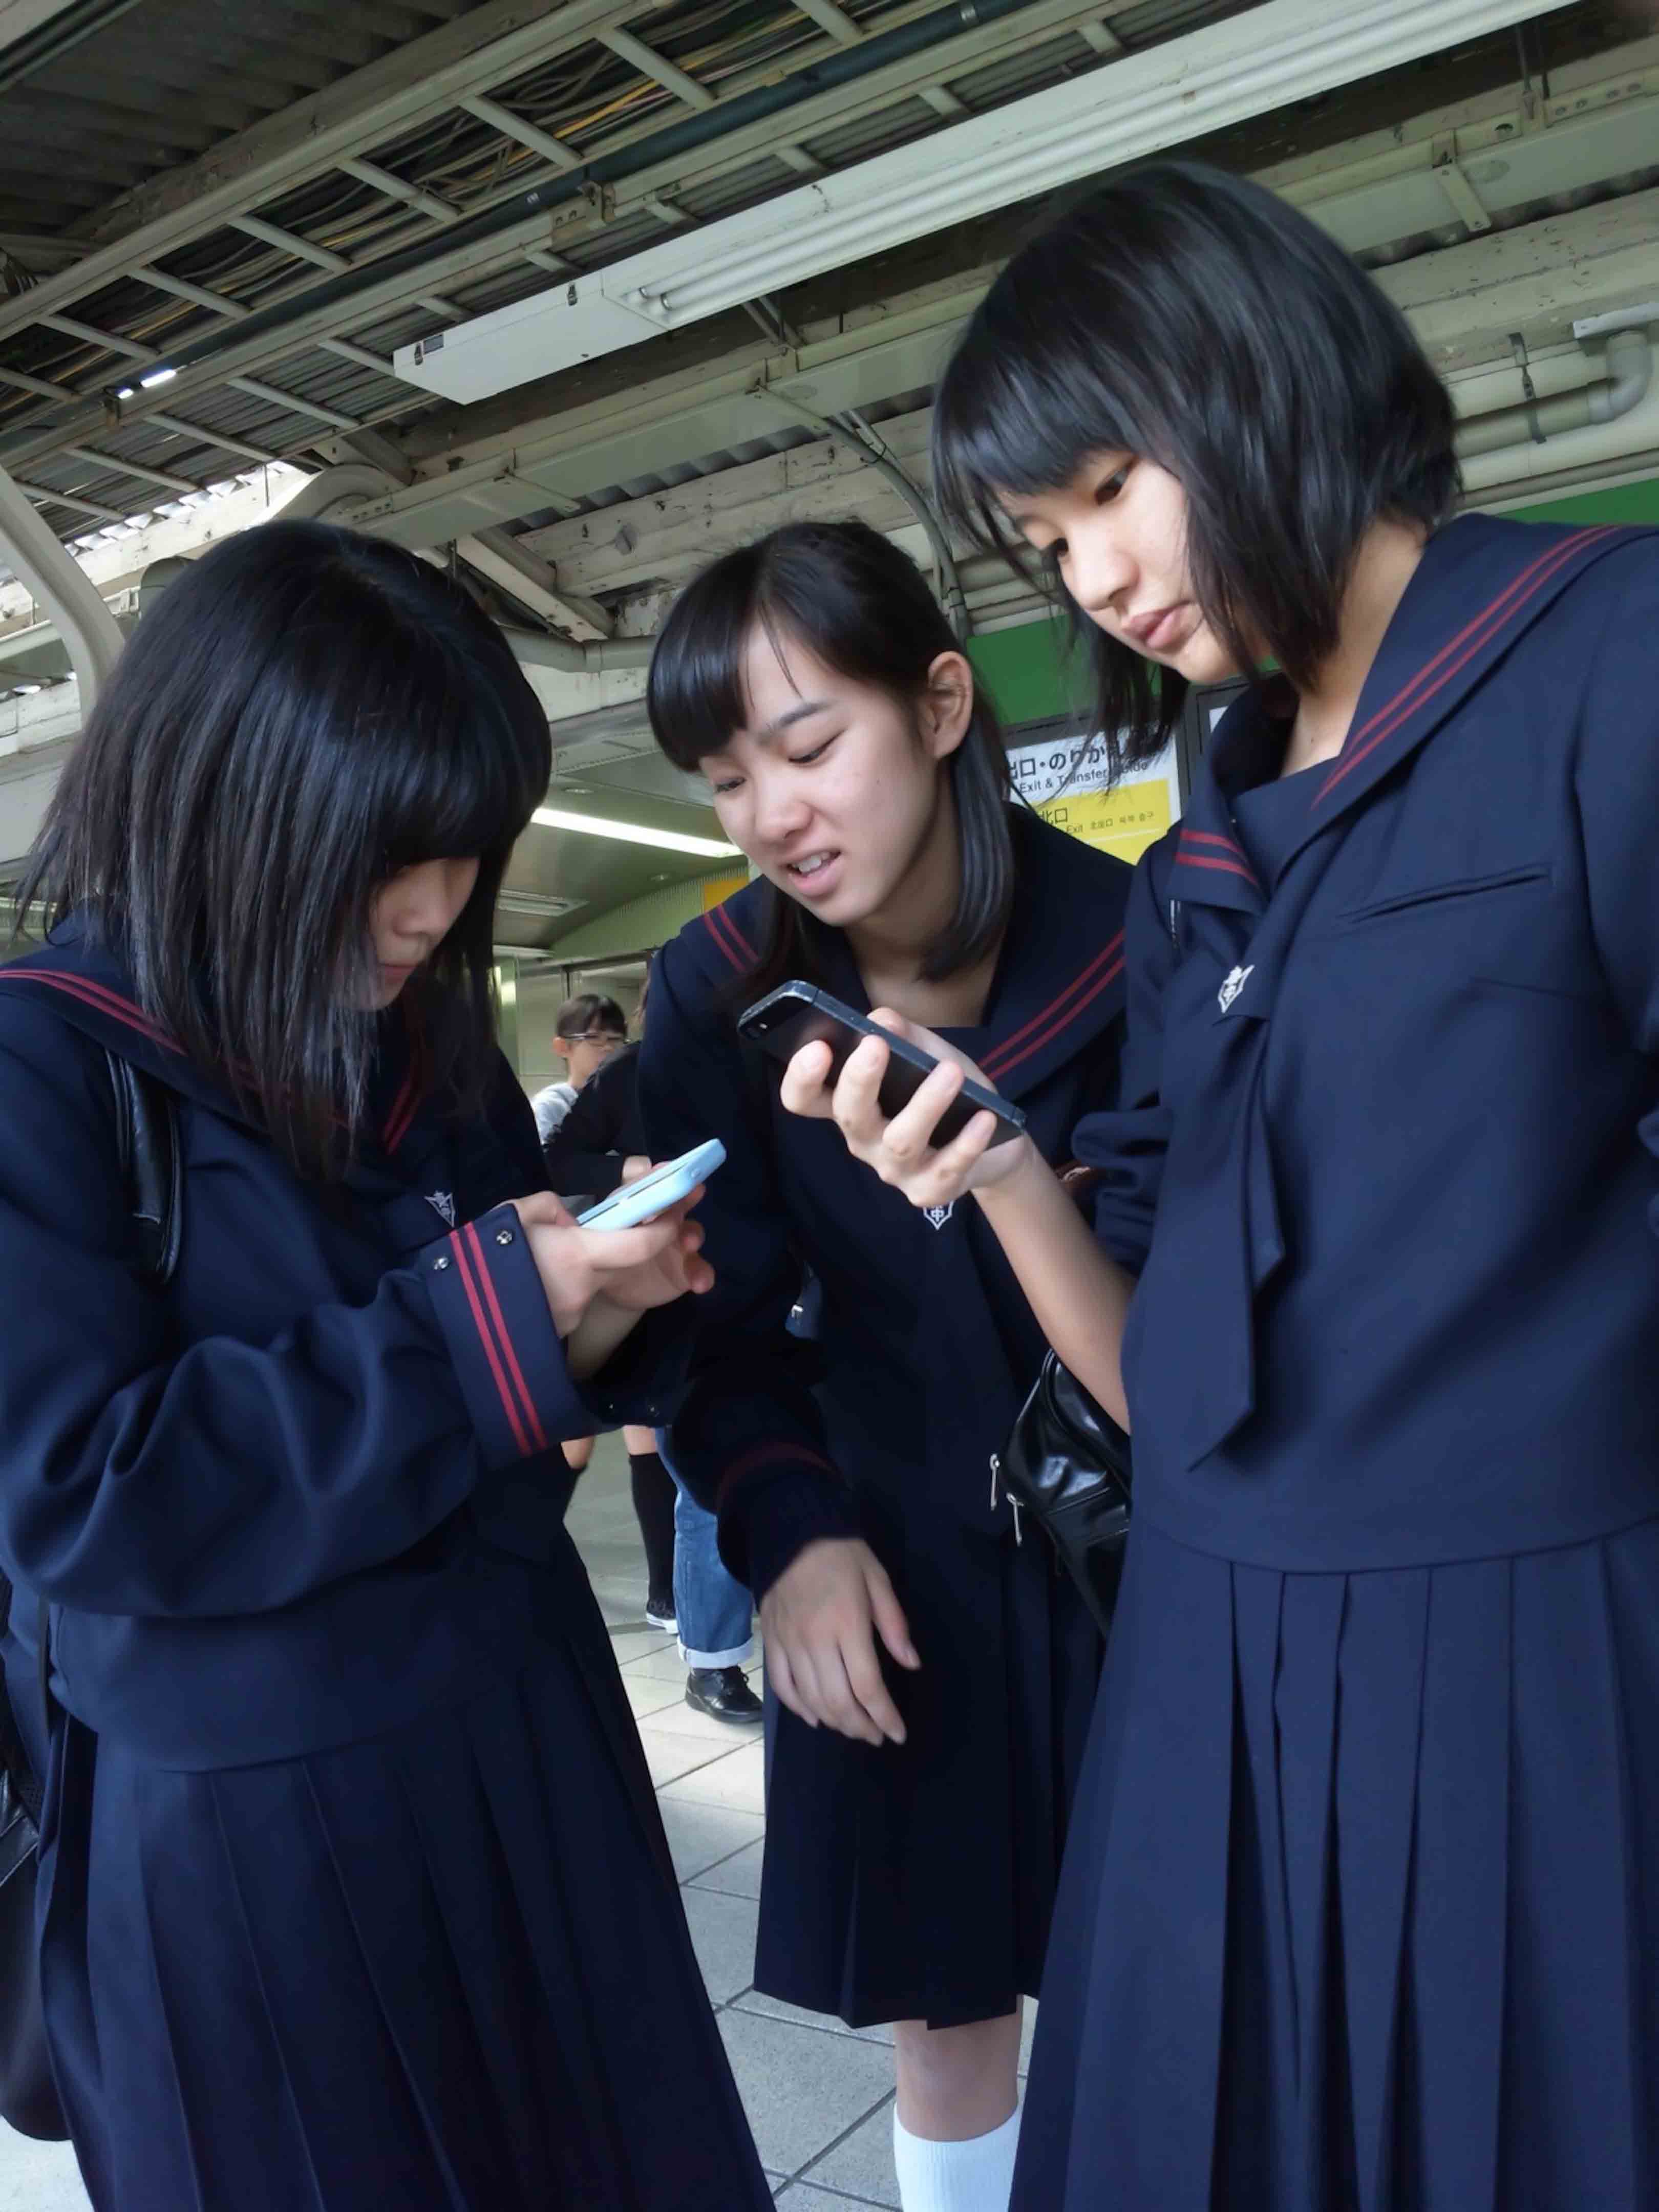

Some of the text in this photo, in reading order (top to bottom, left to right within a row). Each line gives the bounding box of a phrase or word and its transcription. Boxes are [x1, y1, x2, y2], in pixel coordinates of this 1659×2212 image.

[1019, 779, 1041, 793] Exit
[1045, 776, 1053, 788] &
[1056, 769, 1108, 787] Tansfer
